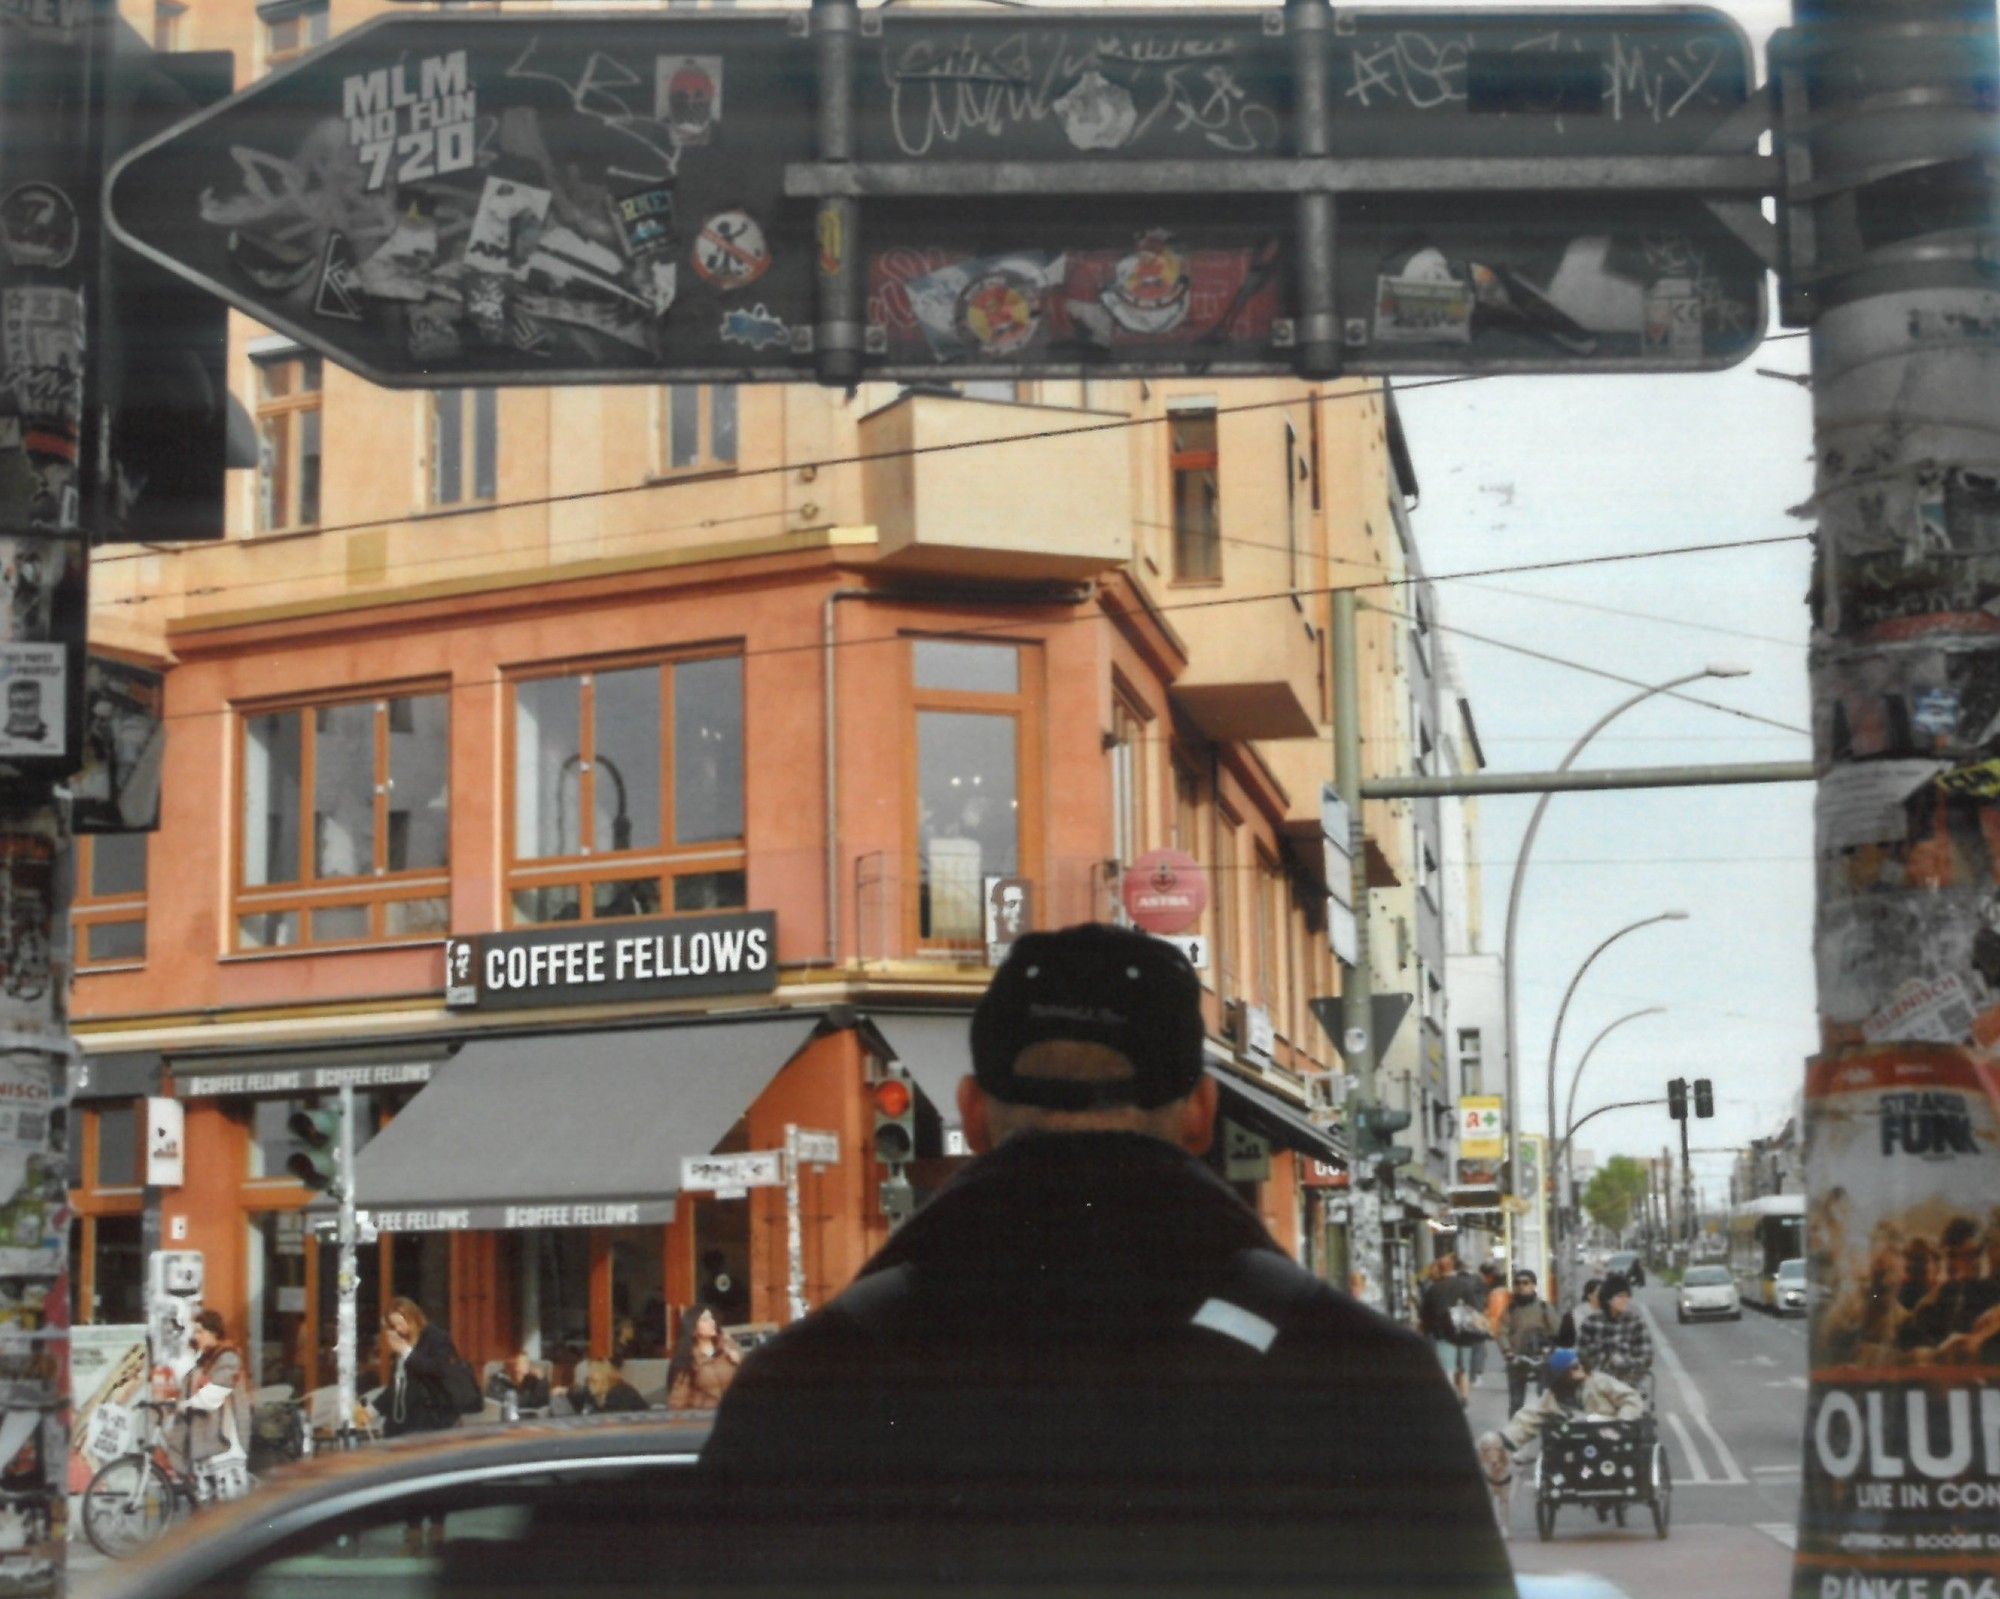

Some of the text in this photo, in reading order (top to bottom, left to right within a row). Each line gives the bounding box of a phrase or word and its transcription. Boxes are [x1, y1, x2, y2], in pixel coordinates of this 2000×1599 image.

[343, 50, 467, 119] MLM
[351, 90, 476, 145] NO FUN
[359, 122, 475, 190] 720
[485, 927, 768, 991] COFFEE FELLOWS
[246, 1071, 300, 1091] FELLOWS
[374, 1063, 431, 1083] FELLOWS
[406, 1208, 470, 1230] FELLOWS
[517, 1203, 639, 1228] COFFEE FELLOWS
[1901, 1483, 1929, 1508] IN
